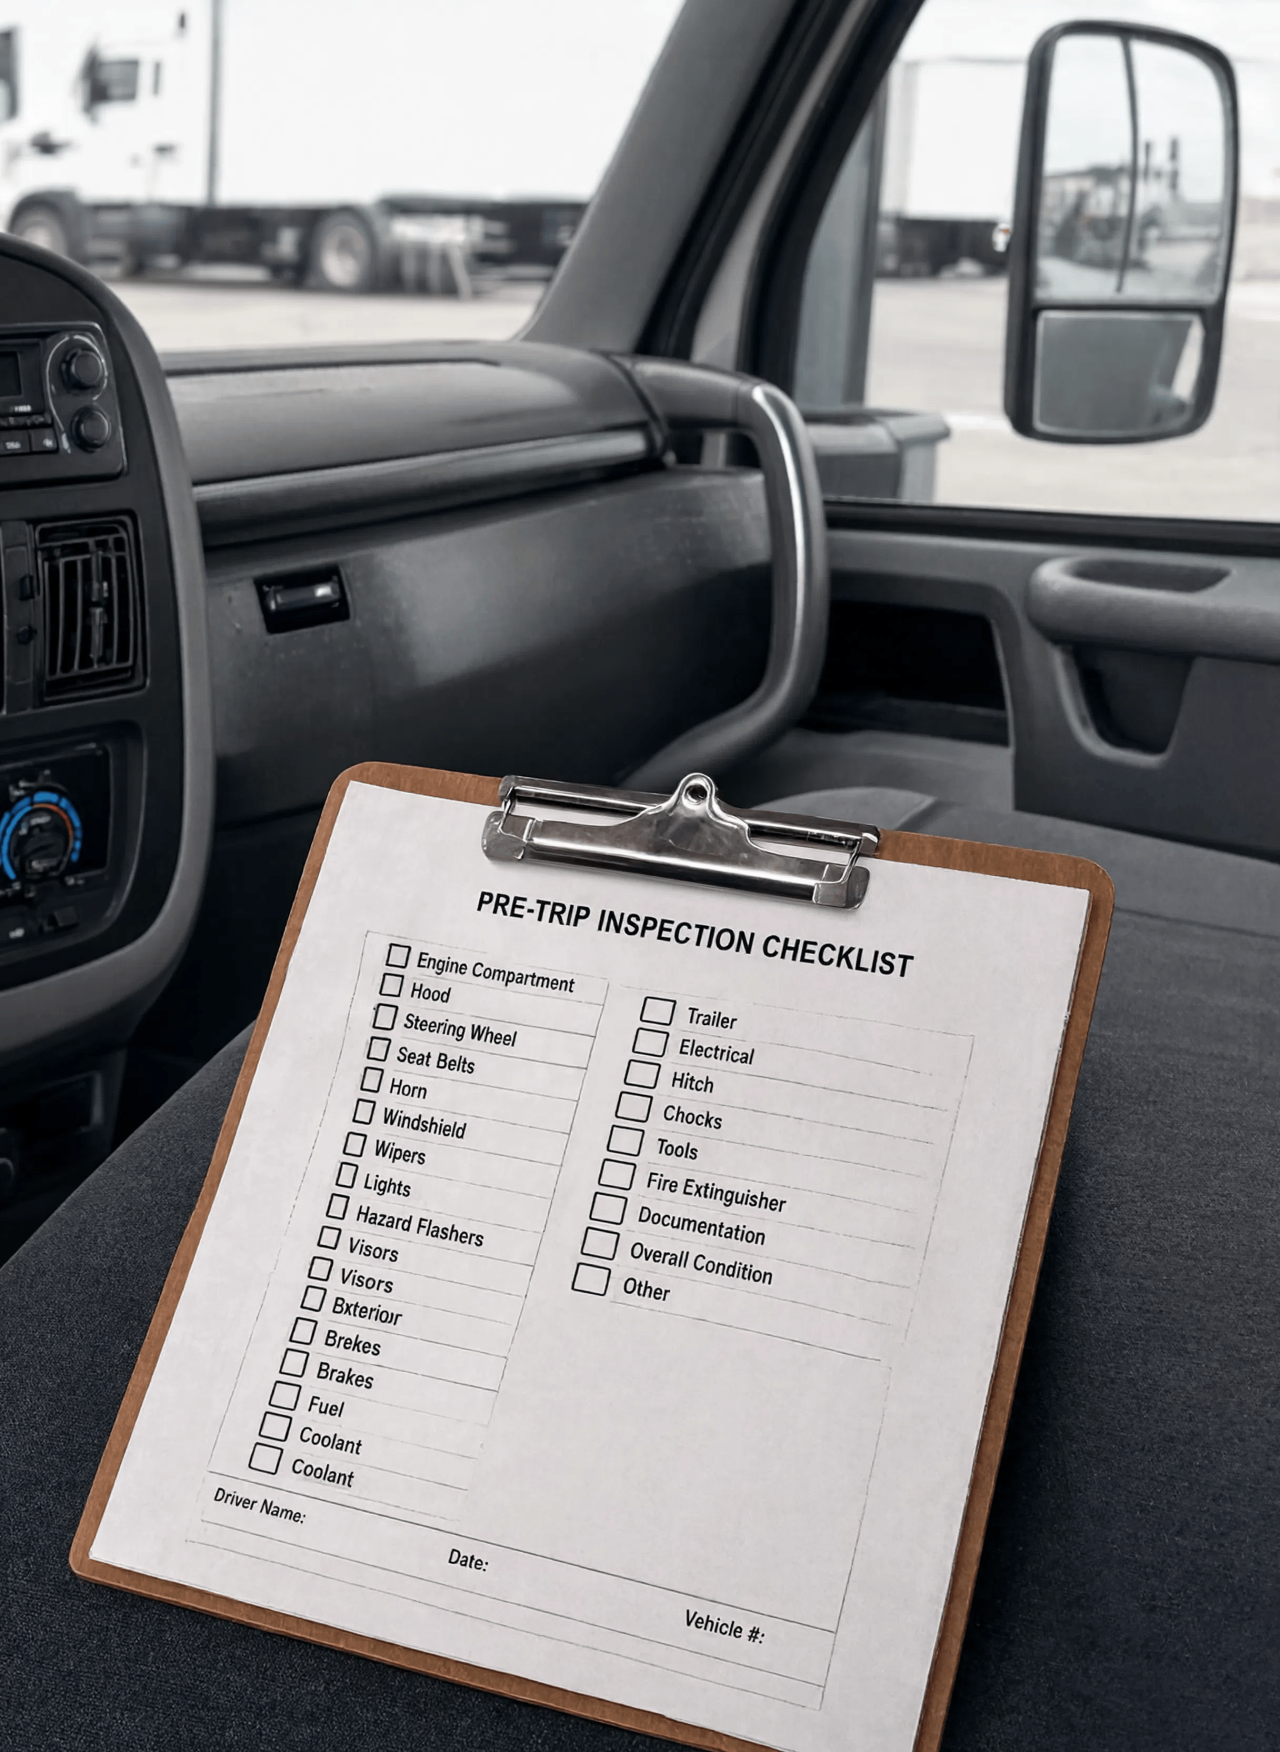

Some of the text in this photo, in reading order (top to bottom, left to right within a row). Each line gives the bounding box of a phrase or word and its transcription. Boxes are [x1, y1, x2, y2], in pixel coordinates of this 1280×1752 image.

[477, 892, 914, 977] PRE-TRIP INSPECTION CHECKLIST
[417, 952, 575, 993] Engine Compartment
[411, 983, 451, 1003] Hood
[404, 1013, 517, 1046] Steering Wheel
[689, 1007, 737, 1029] Trailer
[397, 1047, 475, 1074] Seat Belts
[680, 1039, 754, 1065] Electrical
[390, 1078, 427, 1099] Horn
[672, 1072, 713, 1093] Hitch
[384, 1107, 466, 1139] Windshield
[664, 1105, 722, 1129] Chocks
[376, 1140, 425, 1165] Wipers
[658, 1138, 698, 1160] Tools
[364, 1174, 411, 1197] Lights
[647, 1172, 786, 1212] Fire Extinguisher
[357, 1205, 484, 1246] Hazard Flashers
[638, 1207, 766, 1246] Documentation
[350, 1237, 398, 1262] Visors
[631, 1242, 772, 1285] Overall Condition
[342, 1268, 393, 1293] Visors
[624, 1278, 670, 1301] Other
[325, 1330, 380, 1356] Brekes
[317, 1362, 373, 1389] Brakes
[308, 1396, 344, 1417] Fuel
[300, 1427, 362, 1455] Coolant
[292, 1459, 354, 1487] Coolant
[214, 1488, 307, 1525] Driver Name:
[449, 1549, 488, 1571] Date:
[686, 1609, 764, 1644] Vehicle #:
